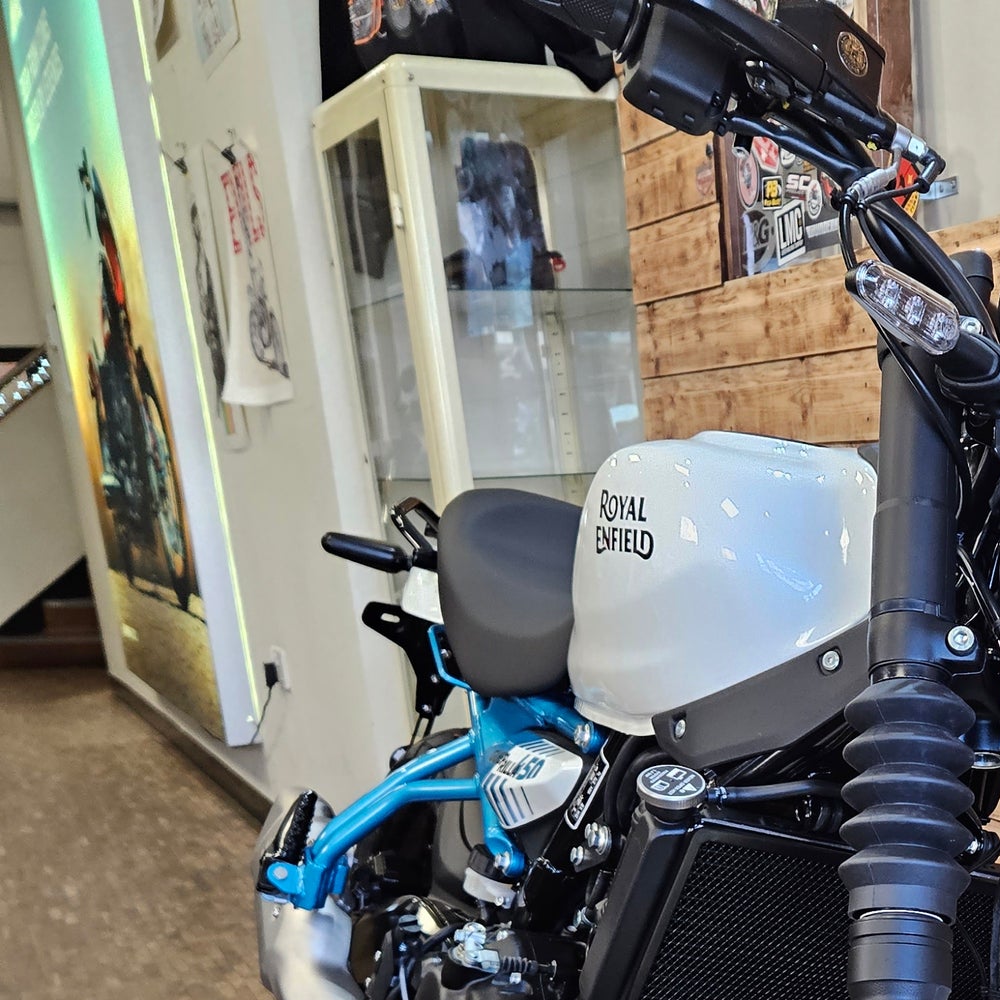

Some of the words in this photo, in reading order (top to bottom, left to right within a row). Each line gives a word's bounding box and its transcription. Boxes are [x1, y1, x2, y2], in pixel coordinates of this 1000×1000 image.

[778, 206, 804, 250] LMC
[599, 488, 648, 523] ROYAL
[595, 525, 655, 561] ENFIELD
